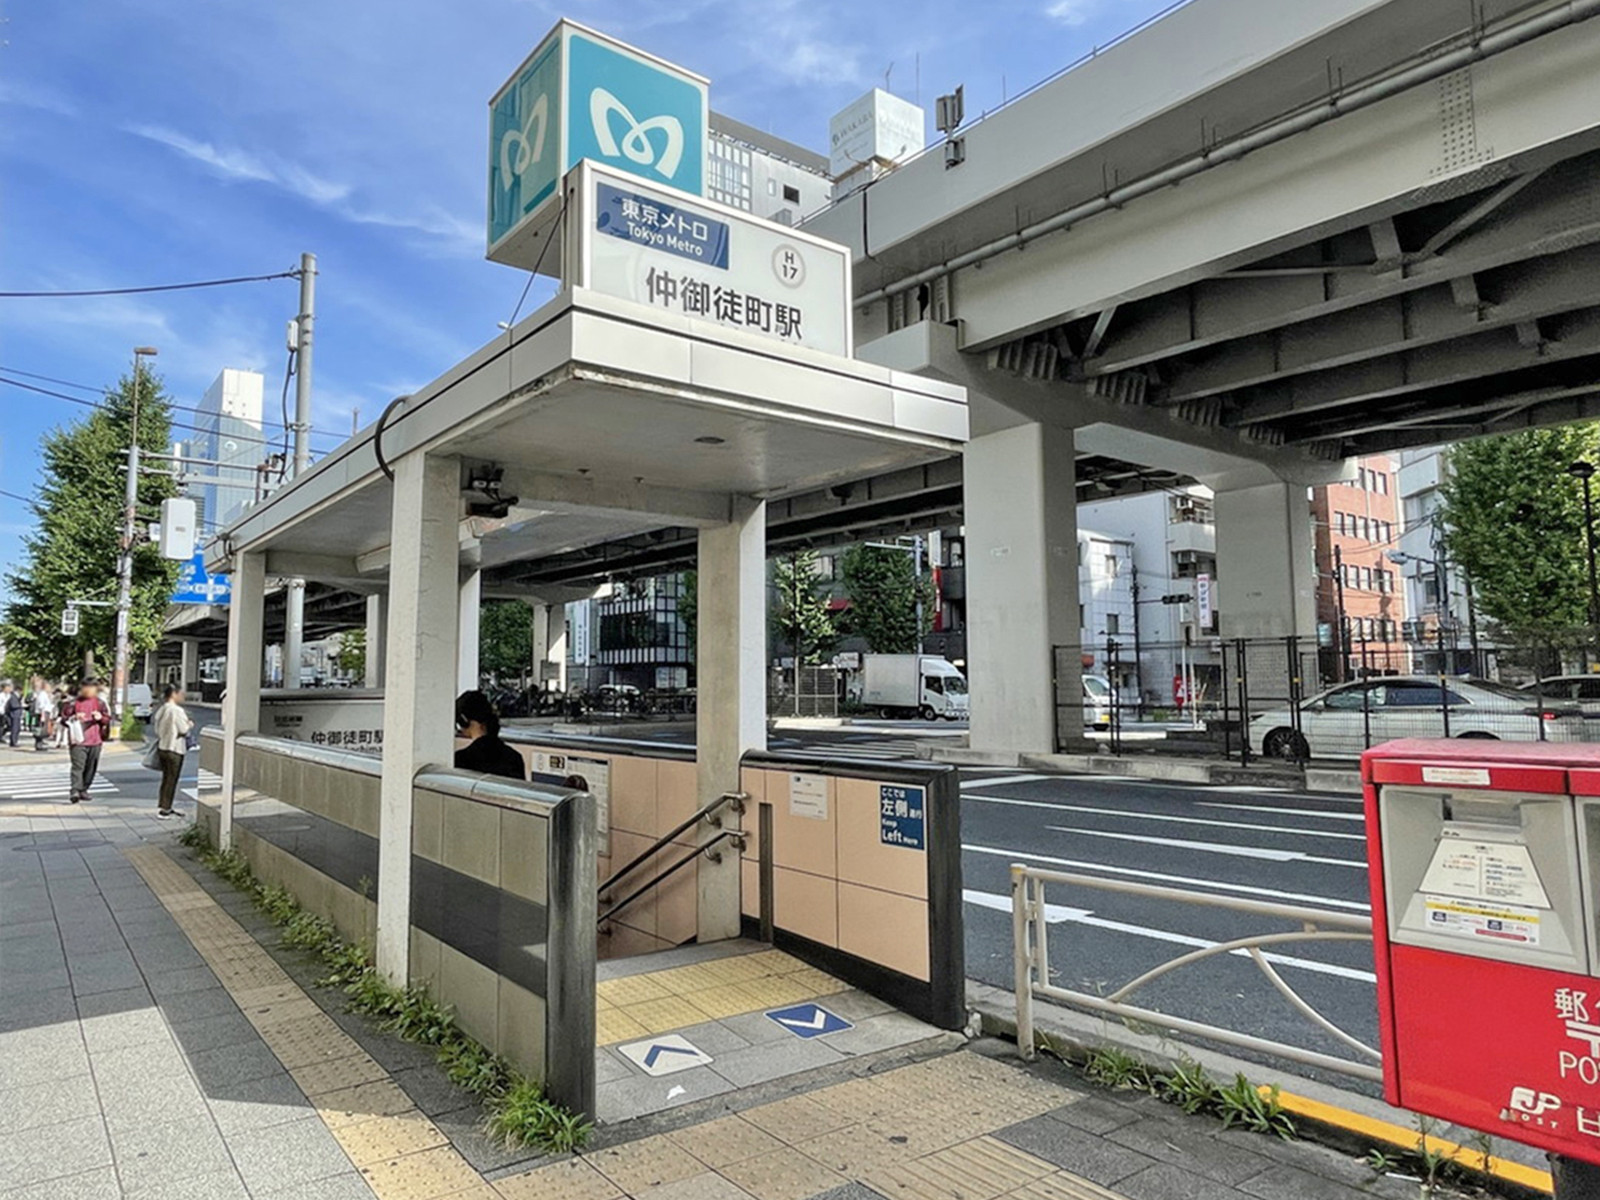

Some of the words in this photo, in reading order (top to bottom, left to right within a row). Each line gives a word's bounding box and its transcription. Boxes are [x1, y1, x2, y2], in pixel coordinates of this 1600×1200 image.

[622, 198, 708, 241] 東京メトロ
[627, 221, 664, 245] Tokyo
[667, 234, 703, 256] Metro
[782, 264, 798, 280] 17
[784, 251, 794, 264] H
[646, 266, 802, 340] 仲御徒町駅
[882, 830, 902, 843] Left
[1558, 1050, 1600, 1085] PO
